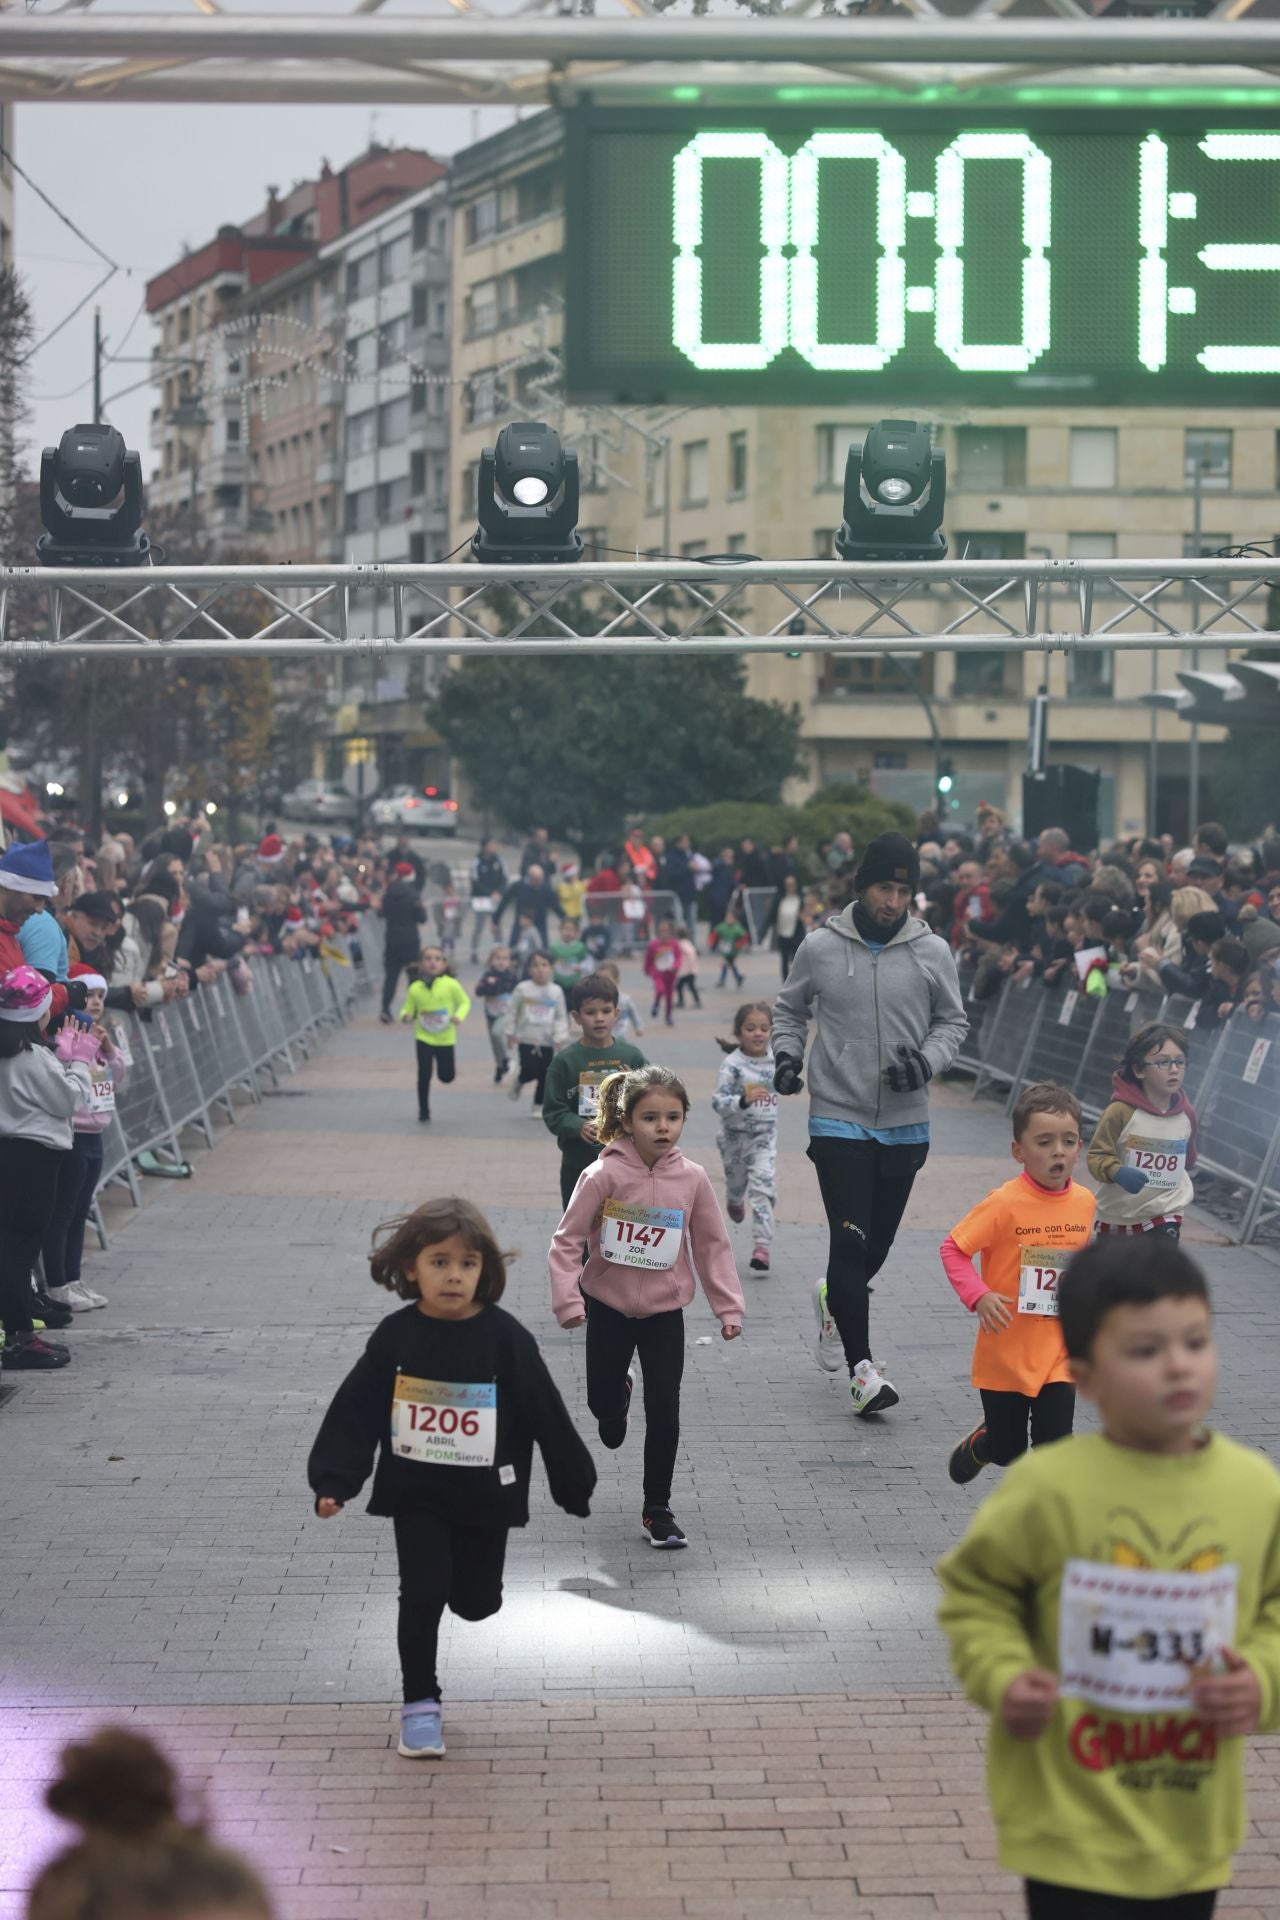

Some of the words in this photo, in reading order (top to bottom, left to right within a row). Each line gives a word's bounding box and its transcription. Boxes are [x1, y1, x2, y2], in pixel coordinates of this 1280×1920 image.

[92, 1082, 113, 1097] 129
[1135, 1151, 1178, 1172] 1208
[1148, 1179, 1177, 1187] DMSiero
[616, 1220, 667, 1248] 1147
[1015, 1226, 1041, 1236] Corre
[1044, 1224, 1062, 1233] con
[628, 1245, 646, 1255] ZOE
[624, 1254, 669, 1268] PDMSiero
[407, 1404, 479, 1437] 1206
[425, 1435, 457, 1447] ABRIL
[425, 1448, 483, 1463] PDMSiero
